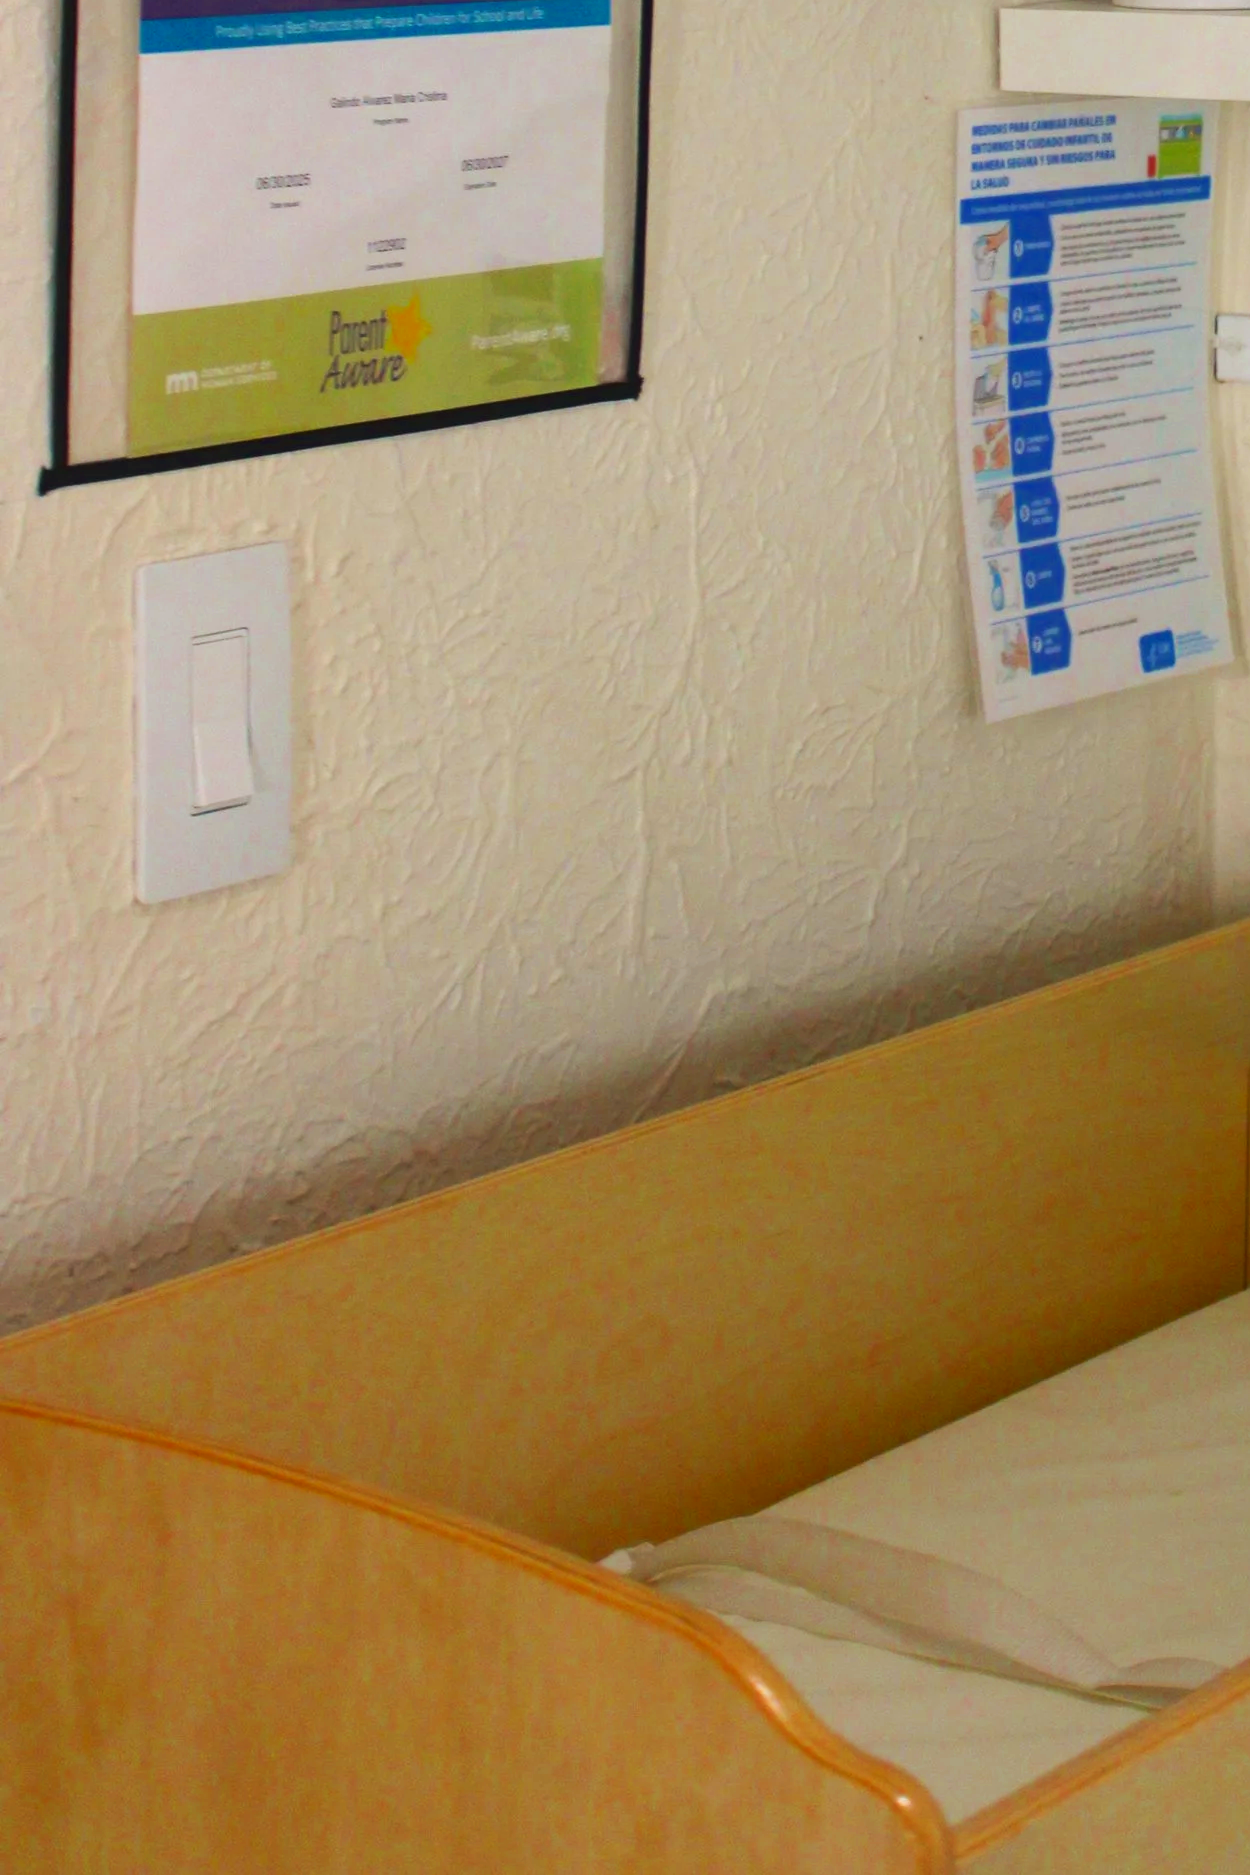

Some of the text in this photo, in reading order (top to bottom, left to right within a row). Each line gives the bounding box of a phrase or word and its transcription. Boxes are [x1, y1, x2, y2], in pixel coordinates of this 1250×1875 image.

[285, 21, 307, 34] Best
[375, 15, 414, 31] Prepare
[416, 13, 456, 26] Children
[474, 10, 506, 23] School
[507, 9, 526, 21] and
[328, 310, 388, 356] Parent
[319, 354, 407, 393] Aware
